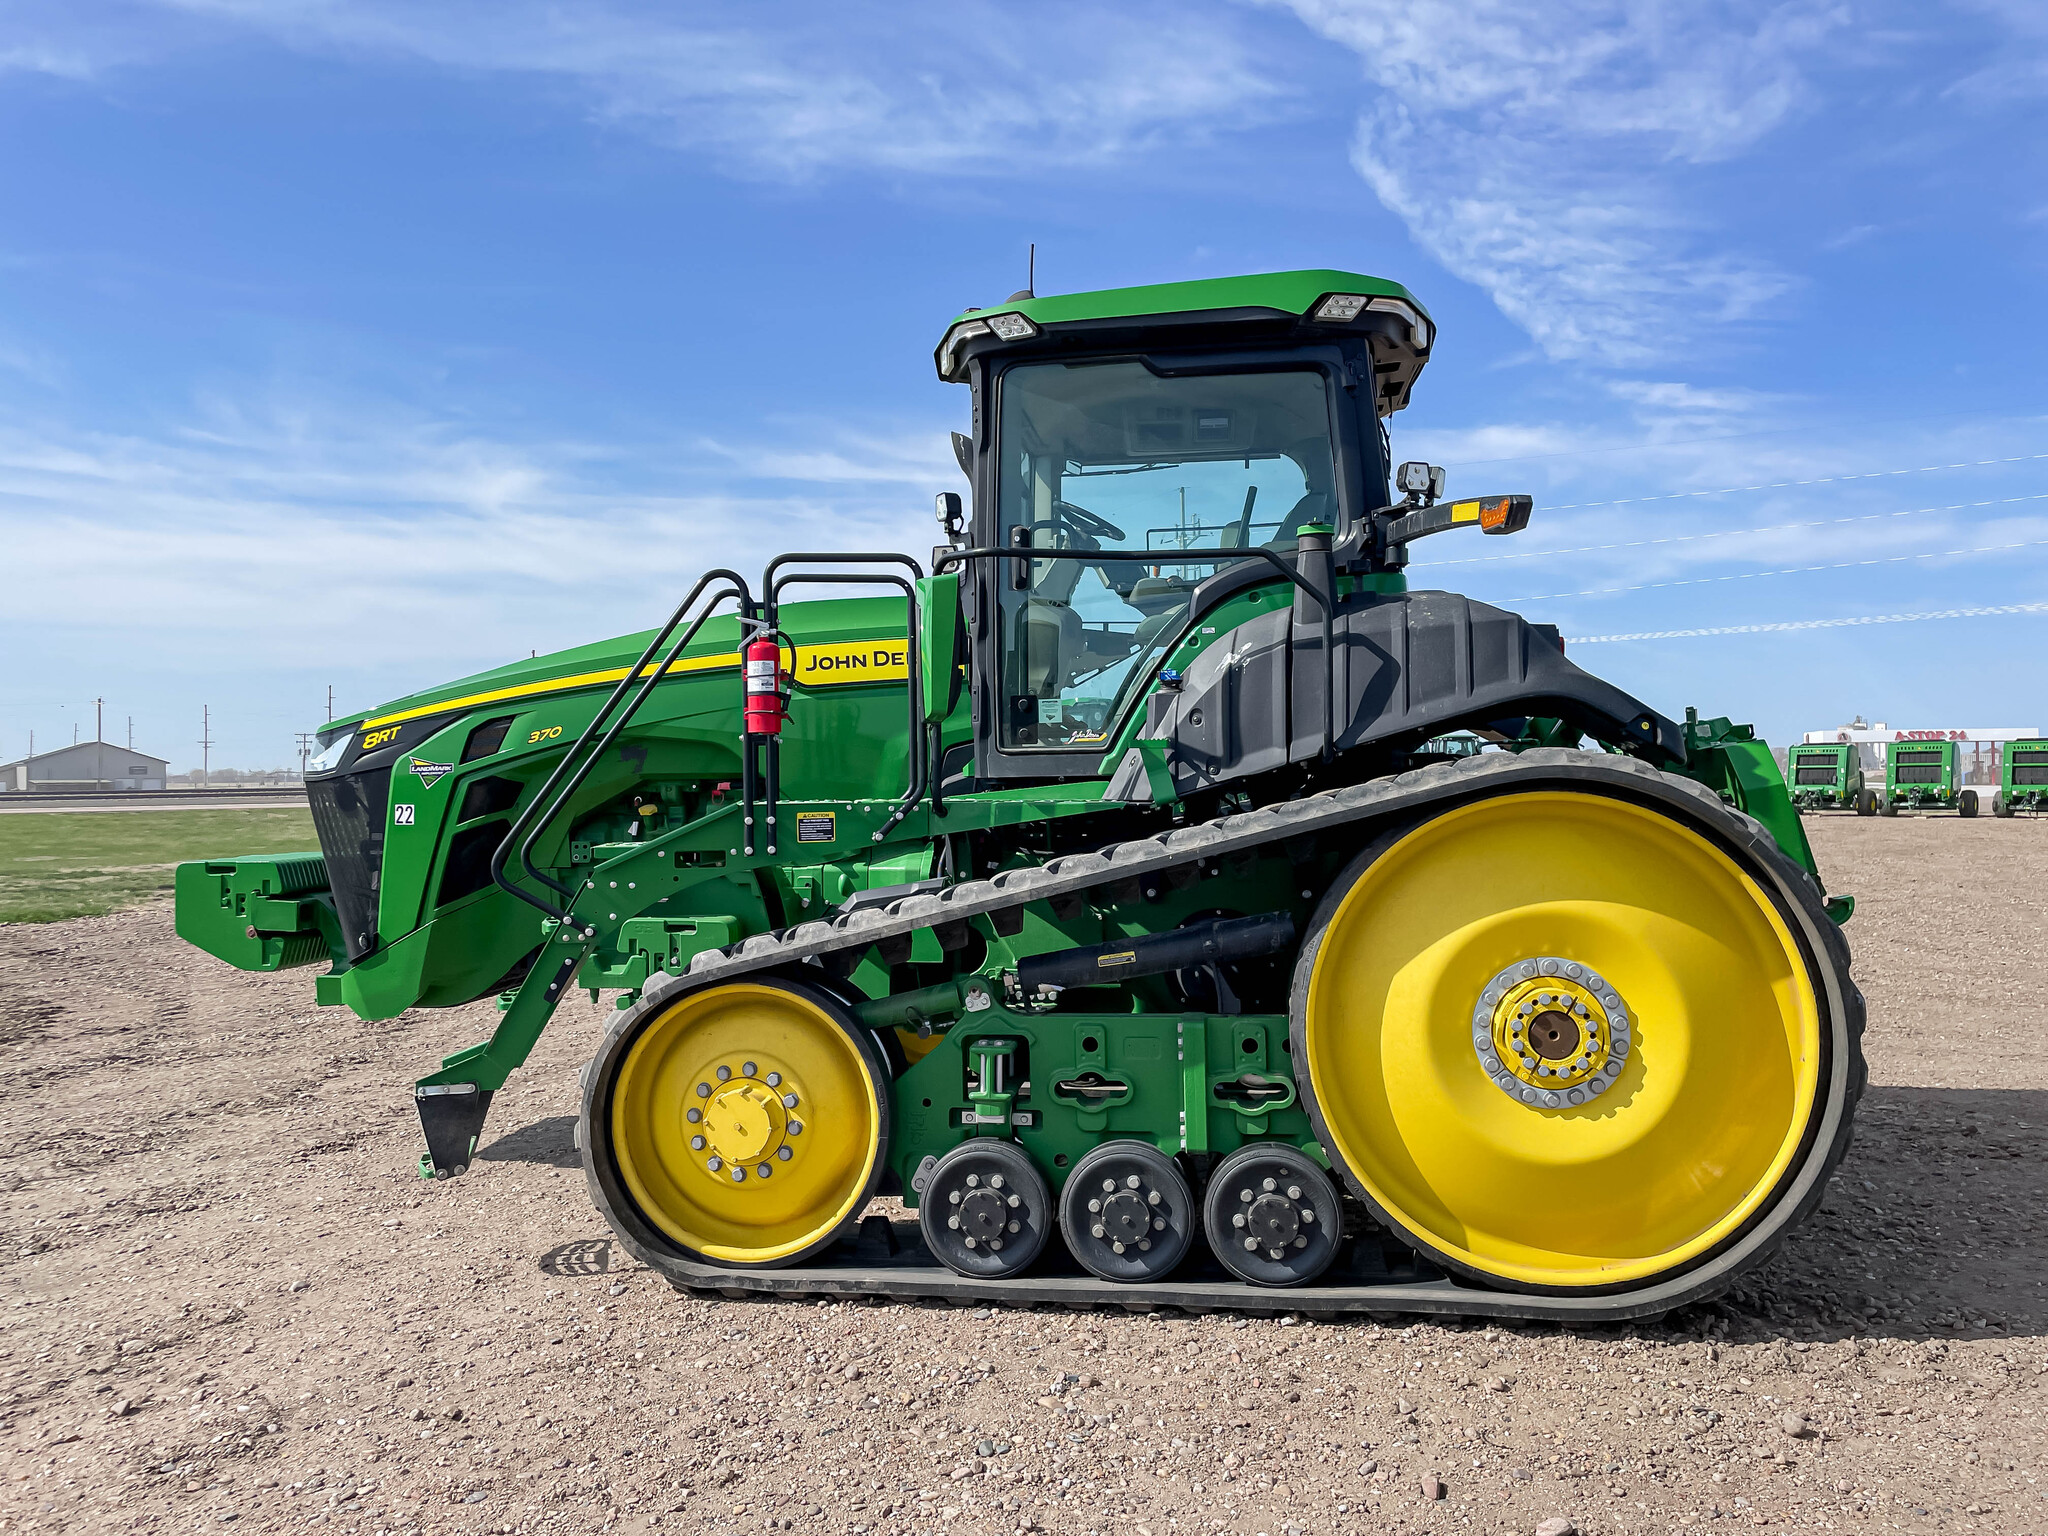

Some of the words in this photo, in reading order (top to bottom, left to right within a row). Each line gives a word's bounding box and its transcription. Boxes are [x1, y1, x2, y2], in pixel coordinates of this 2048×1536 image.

[805, 654, 867, 672] JOHN
[362, 726, 402, 750] 8RT
[527, 725, 563, 744] 370
[1949, 730, 1967, 740] 24
[395, 806, 414, 824] 22
